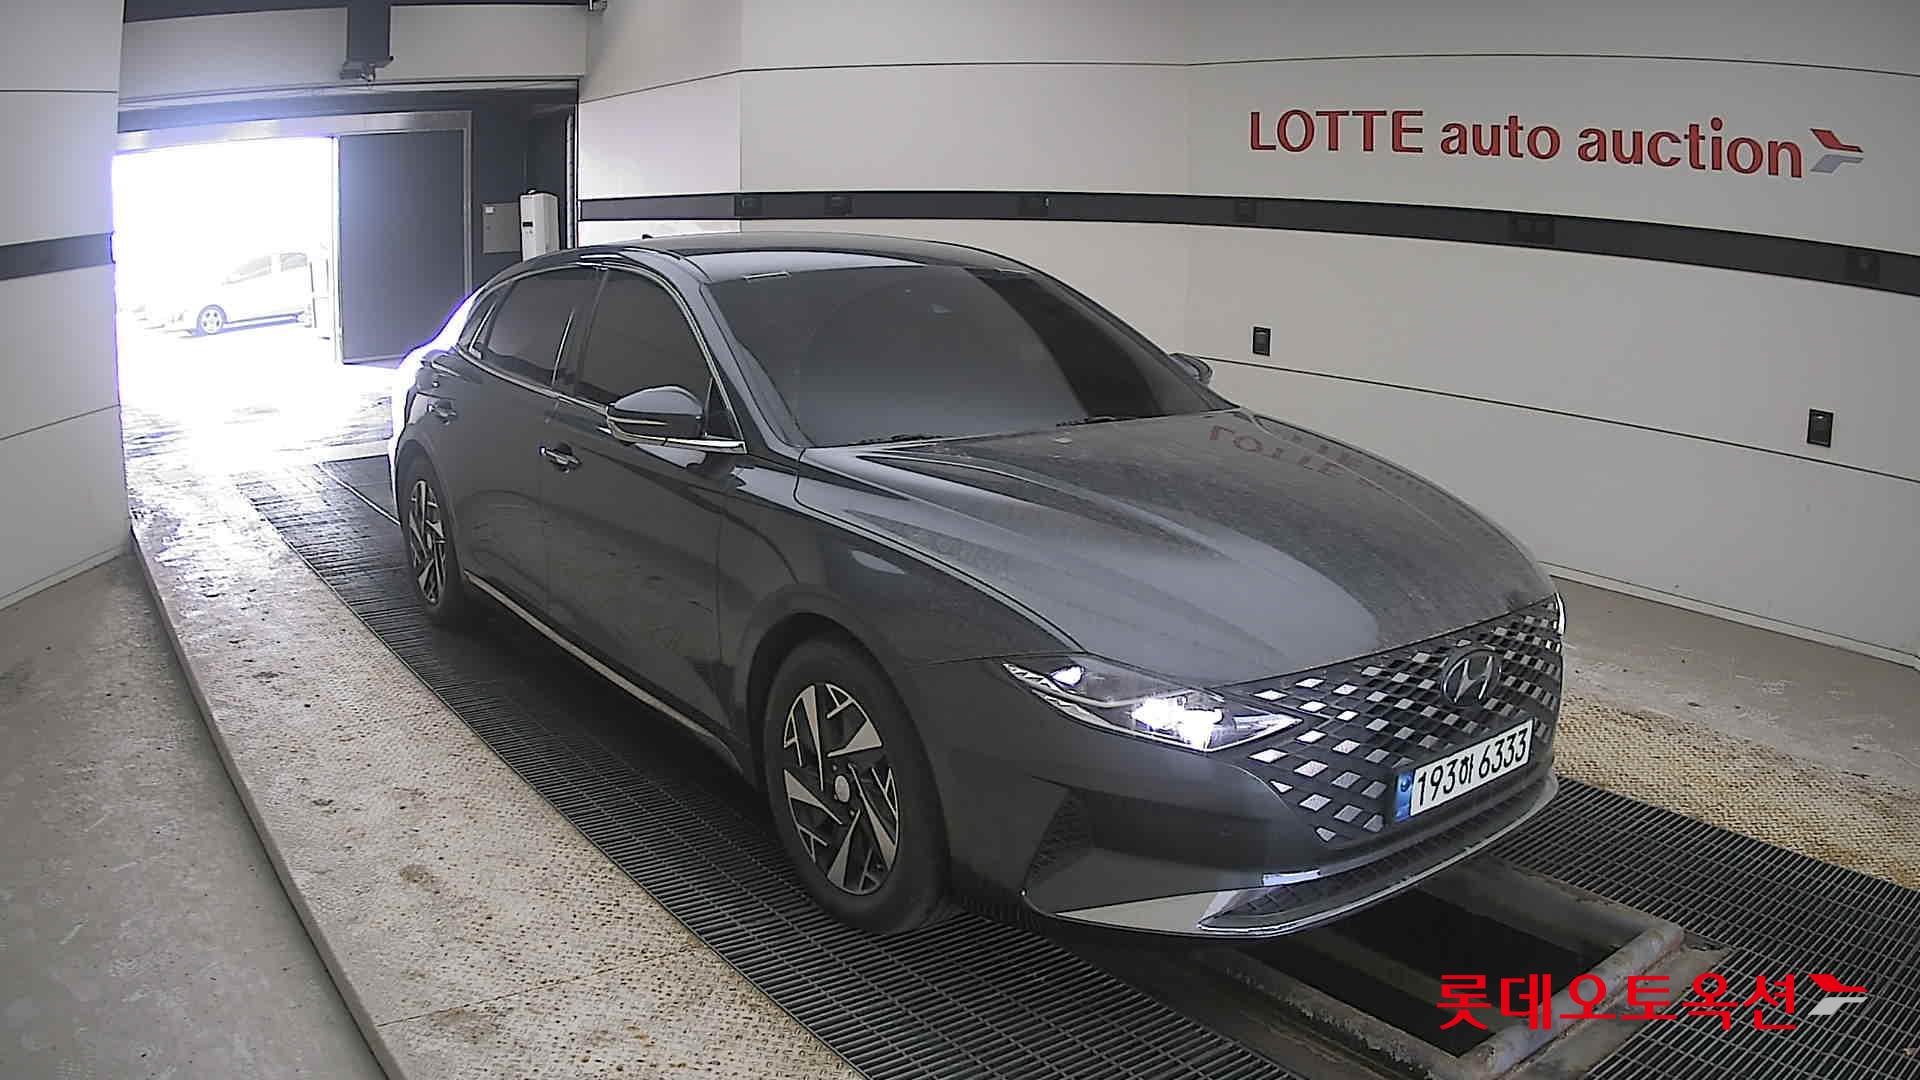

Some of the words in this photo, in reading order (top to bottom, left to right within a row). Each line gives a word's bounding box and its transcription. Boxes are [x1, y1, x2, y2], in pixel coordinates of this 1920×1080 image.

[1249, 110, 1424, 154] LOTTE
[1440, 115, 1562, 161] auto
[1577, 117, 1803, 178] auction
[1417, 753, 1474, 806] 193하
[1479, 728, 1528, 779] 6333
